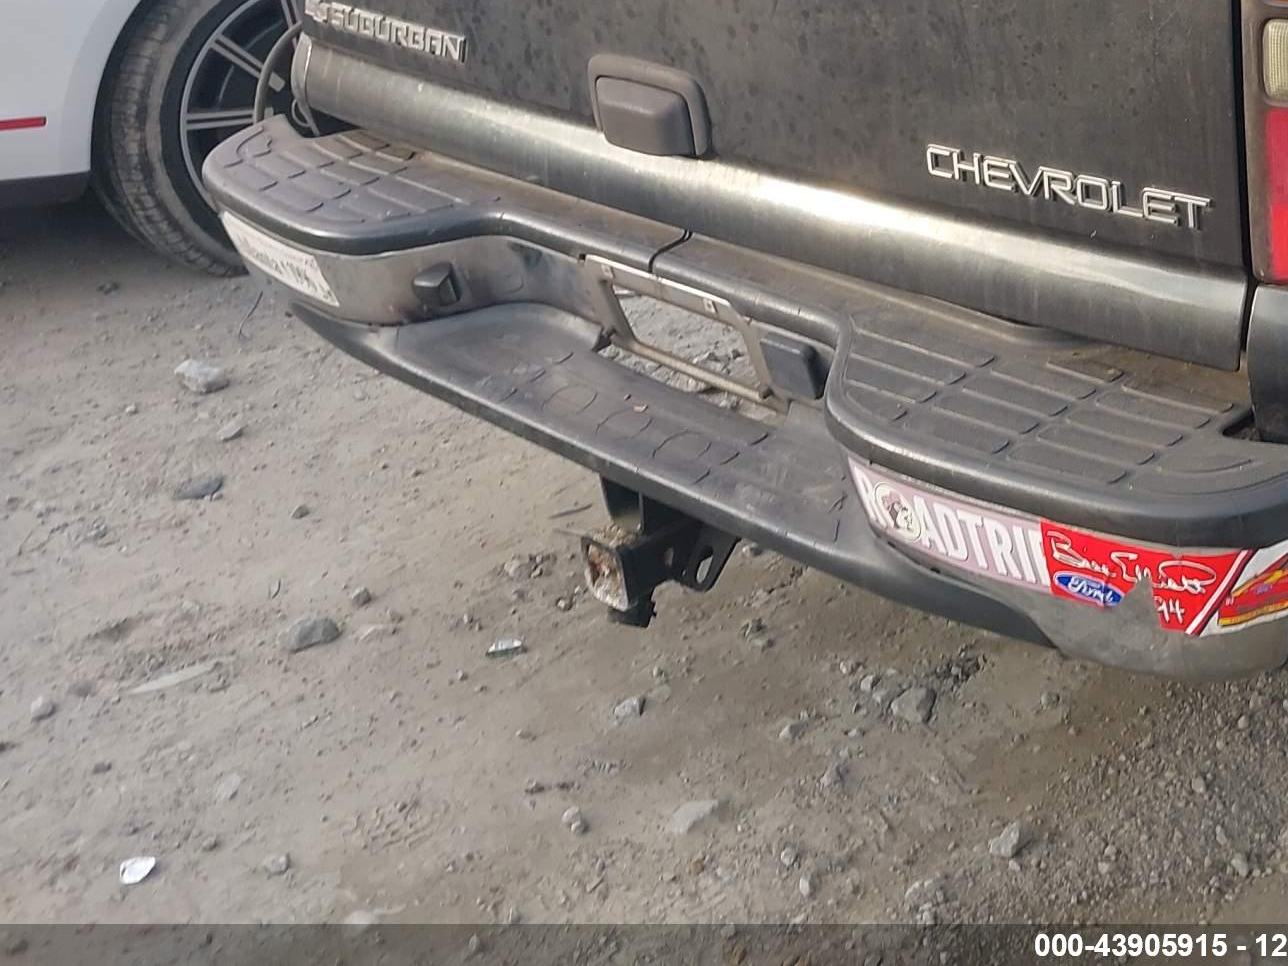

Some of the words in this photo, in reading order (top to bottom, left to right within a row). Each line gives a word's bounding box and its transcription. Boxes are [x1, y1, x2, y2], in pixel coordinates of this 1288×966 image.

[330, 1, 468, 64] SUBURBAN
[926, 143, 1212, 231] CHEVROLET
[1067, 574, 1115, 605] Ford
